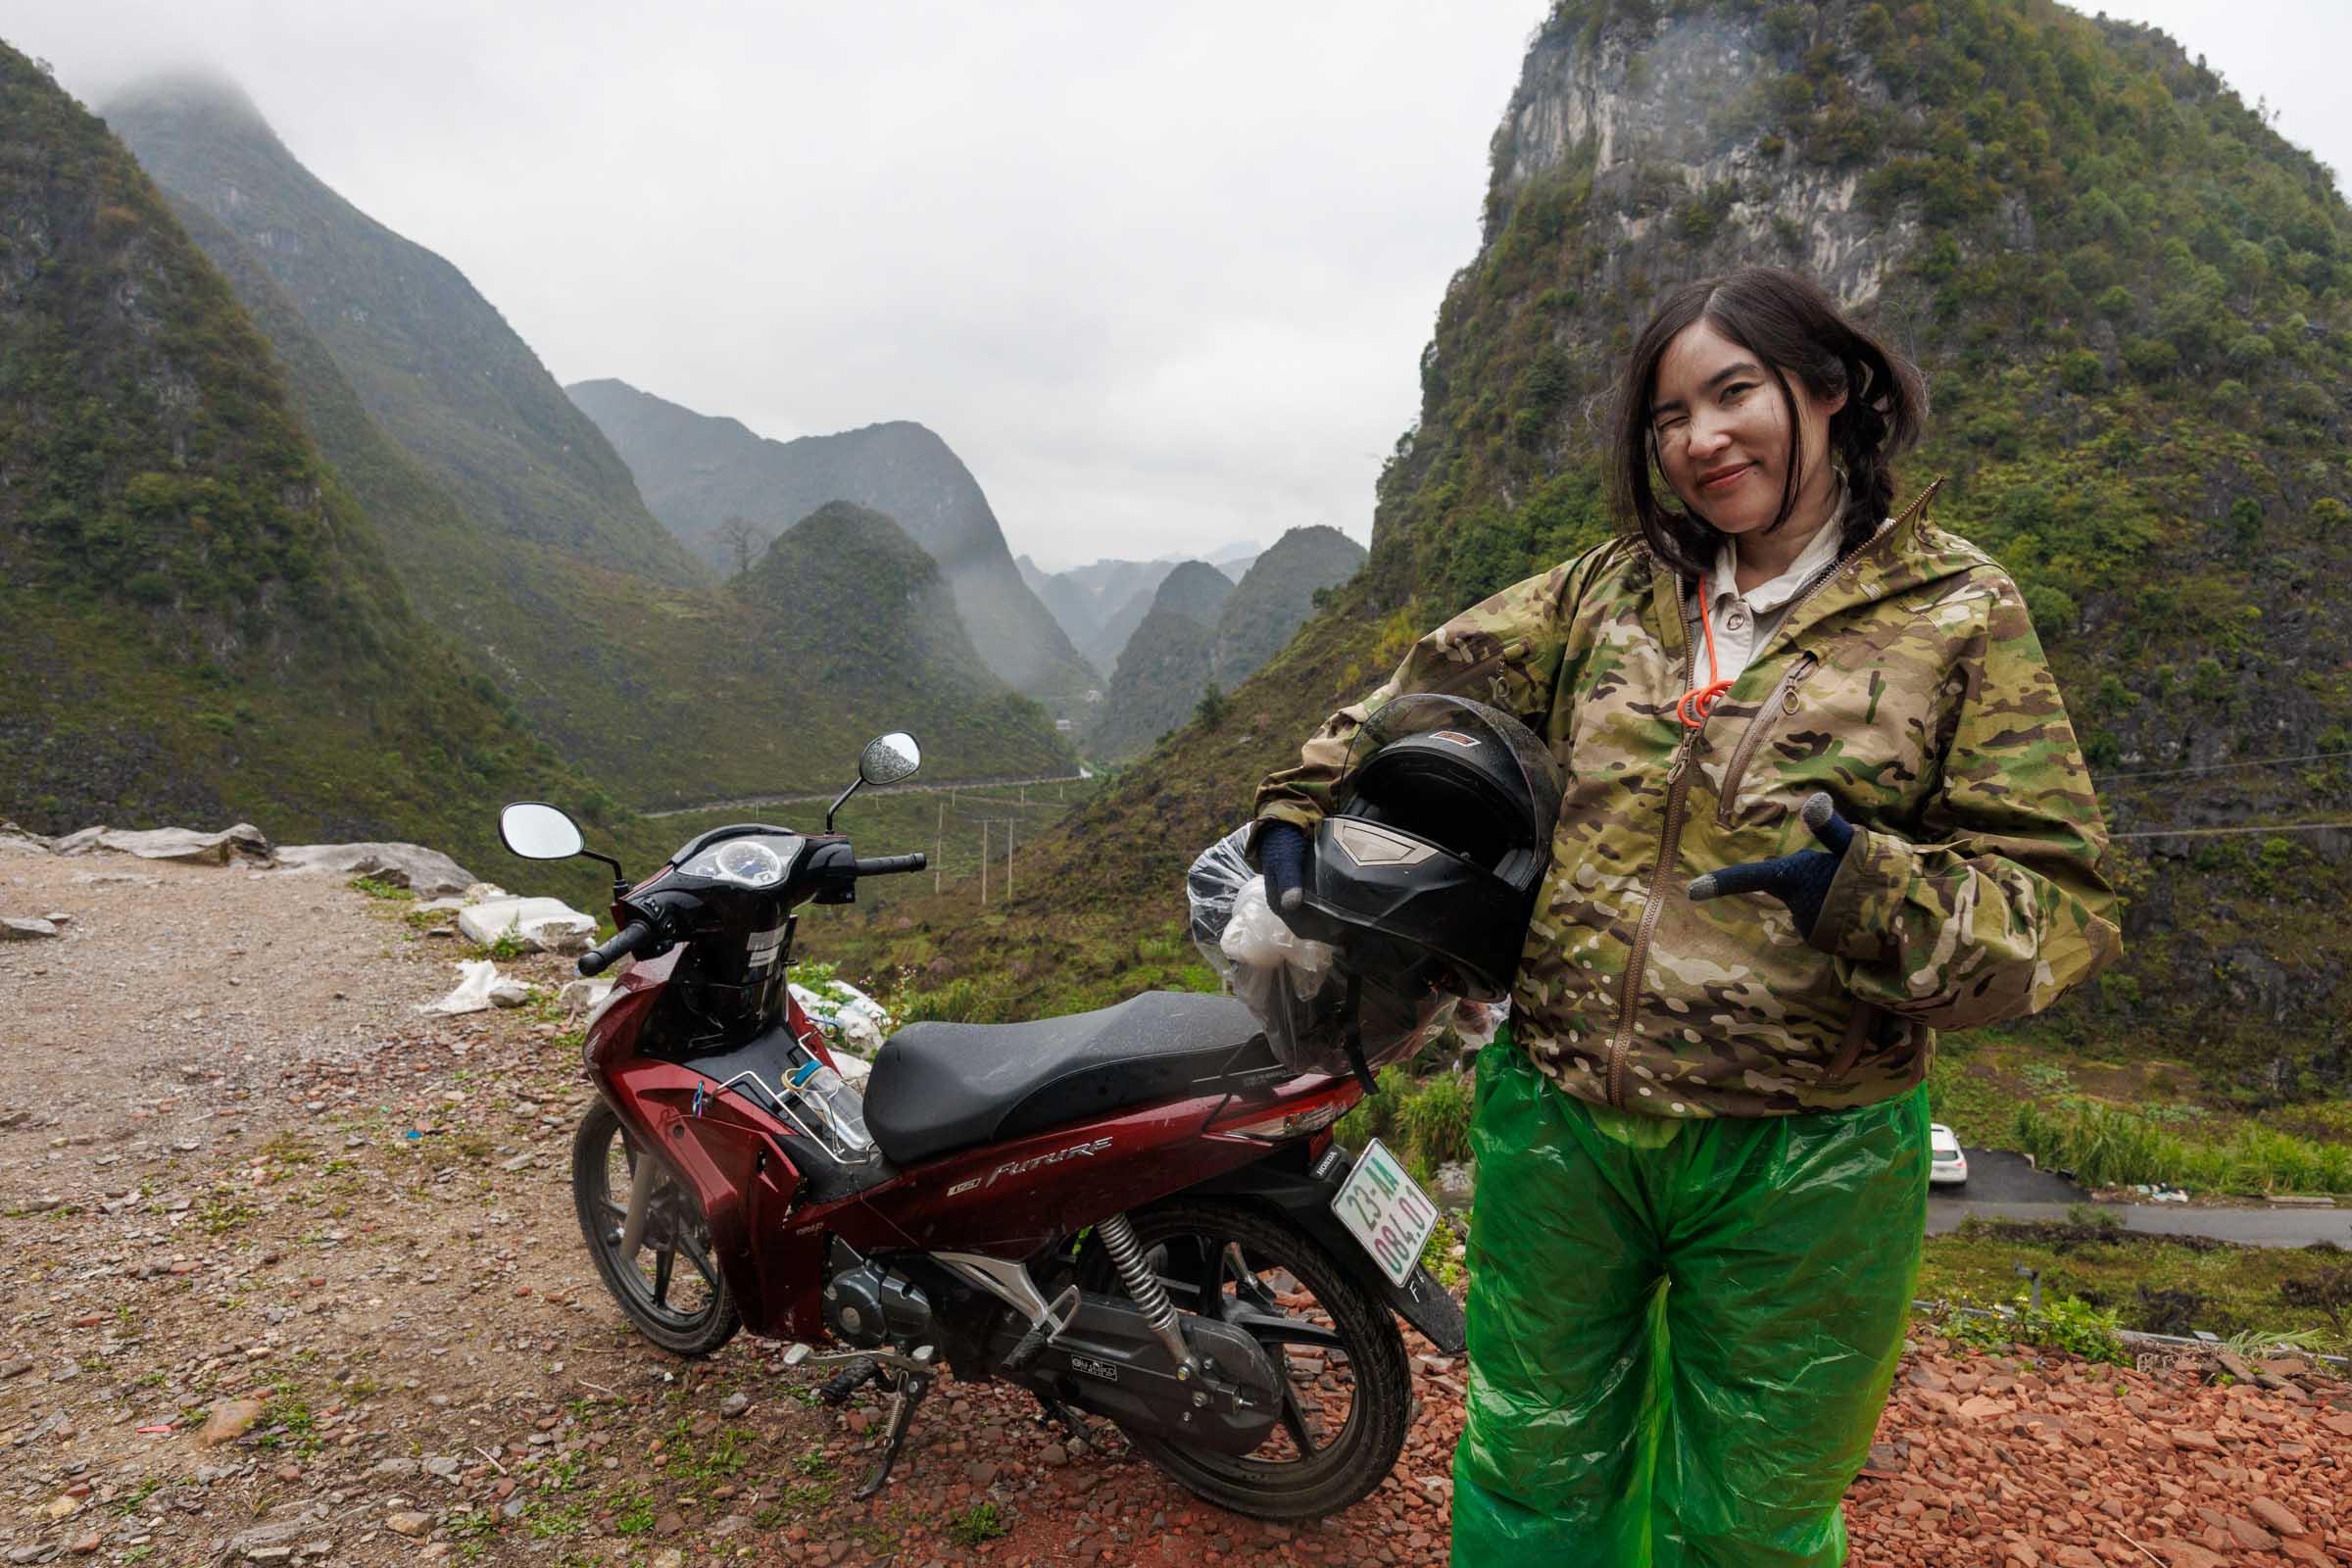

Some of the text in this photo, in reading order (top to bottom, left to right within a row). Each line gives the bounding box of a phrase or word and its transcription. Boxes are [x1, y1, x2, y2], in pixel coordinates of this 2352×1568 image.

[986, 1136, 1113, 1189] FUTURE
[1316, 1152, 1338, 1176] HONDA
[1375, 1185, 1433, 1275] 084.01
